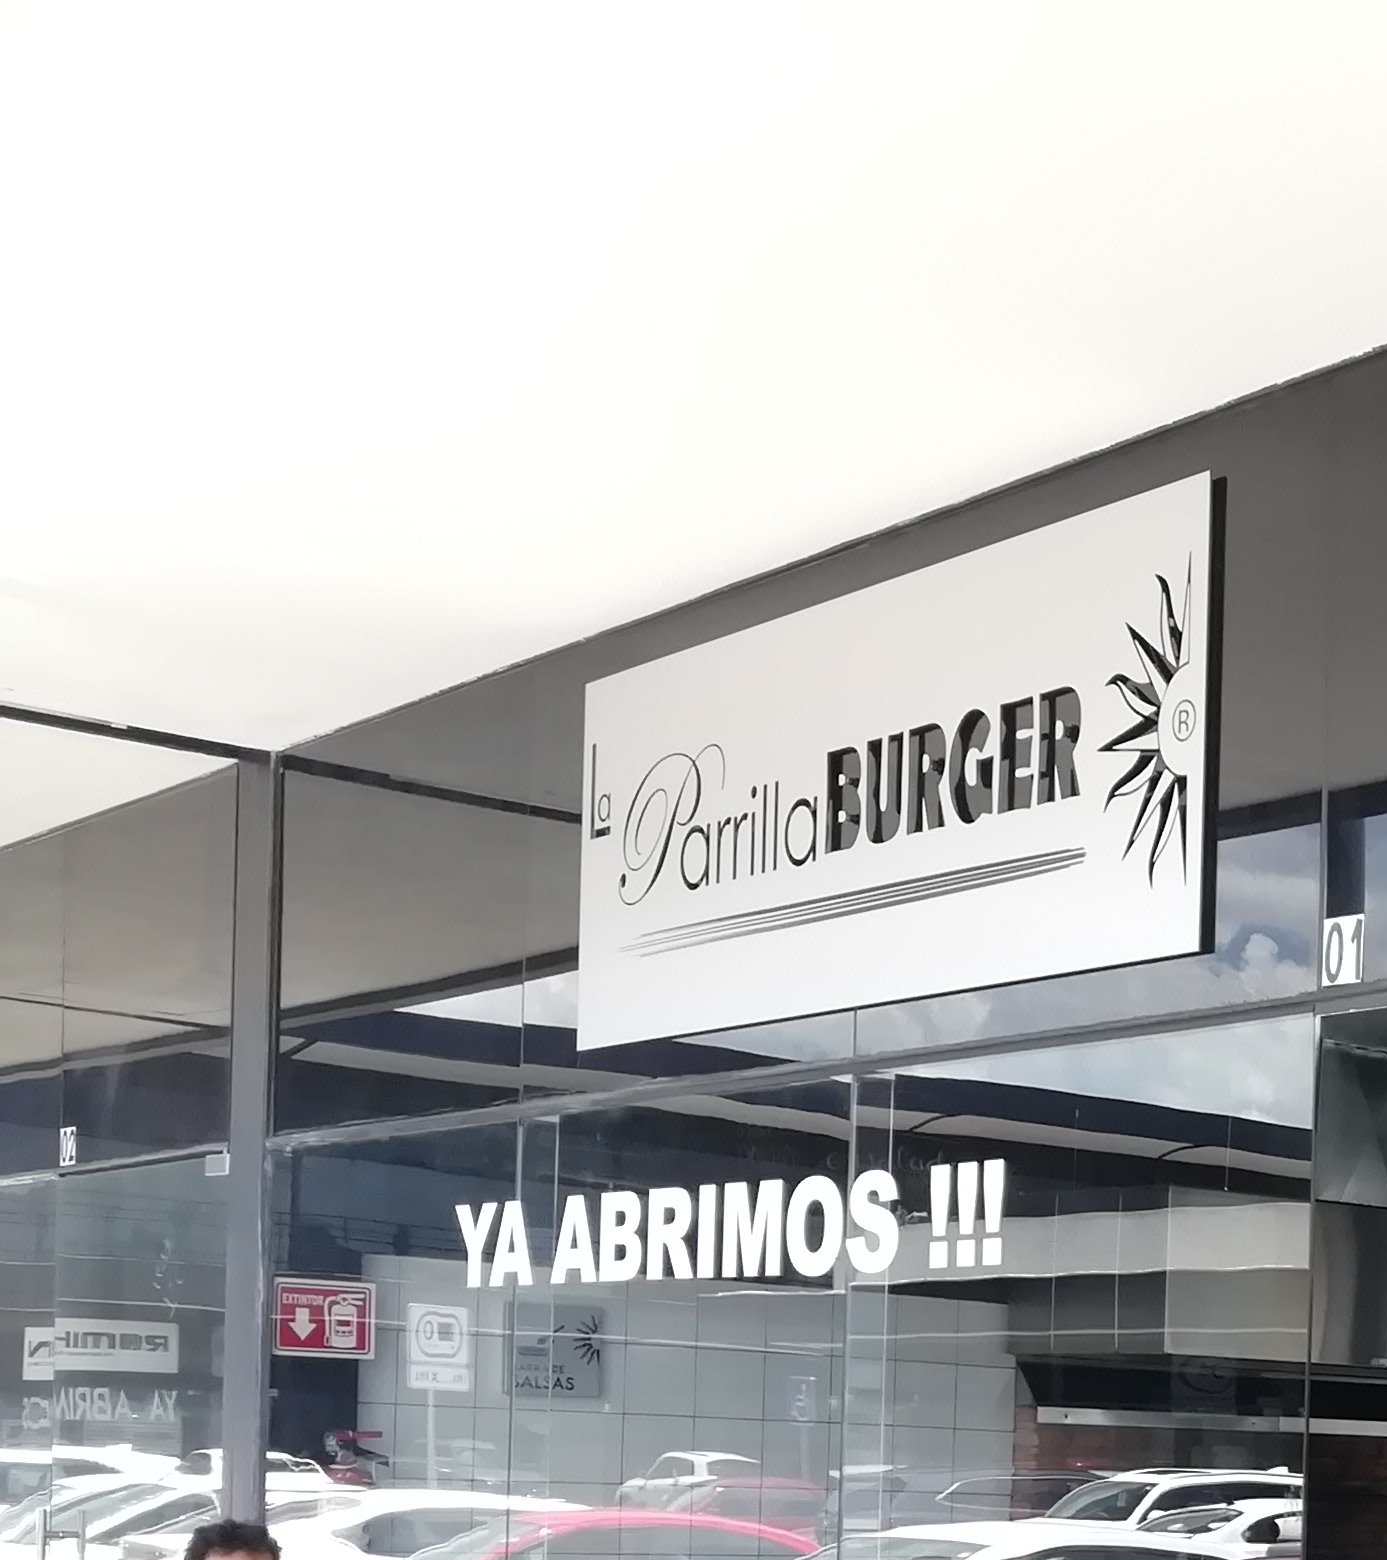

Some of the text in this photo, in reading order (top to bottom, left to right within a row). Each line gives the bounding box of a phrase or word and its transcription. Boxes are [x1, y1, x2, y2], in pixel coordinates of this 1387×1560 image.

[590, 685, 1082, 906] La Parrilla BURGER
[1325, 918, 1364, 984] 01
[61, 1129, 76, 1163] 02
[455, 1199, 533, 1288] YA
[550, 1169, 900, 1285] ABRIMOS
